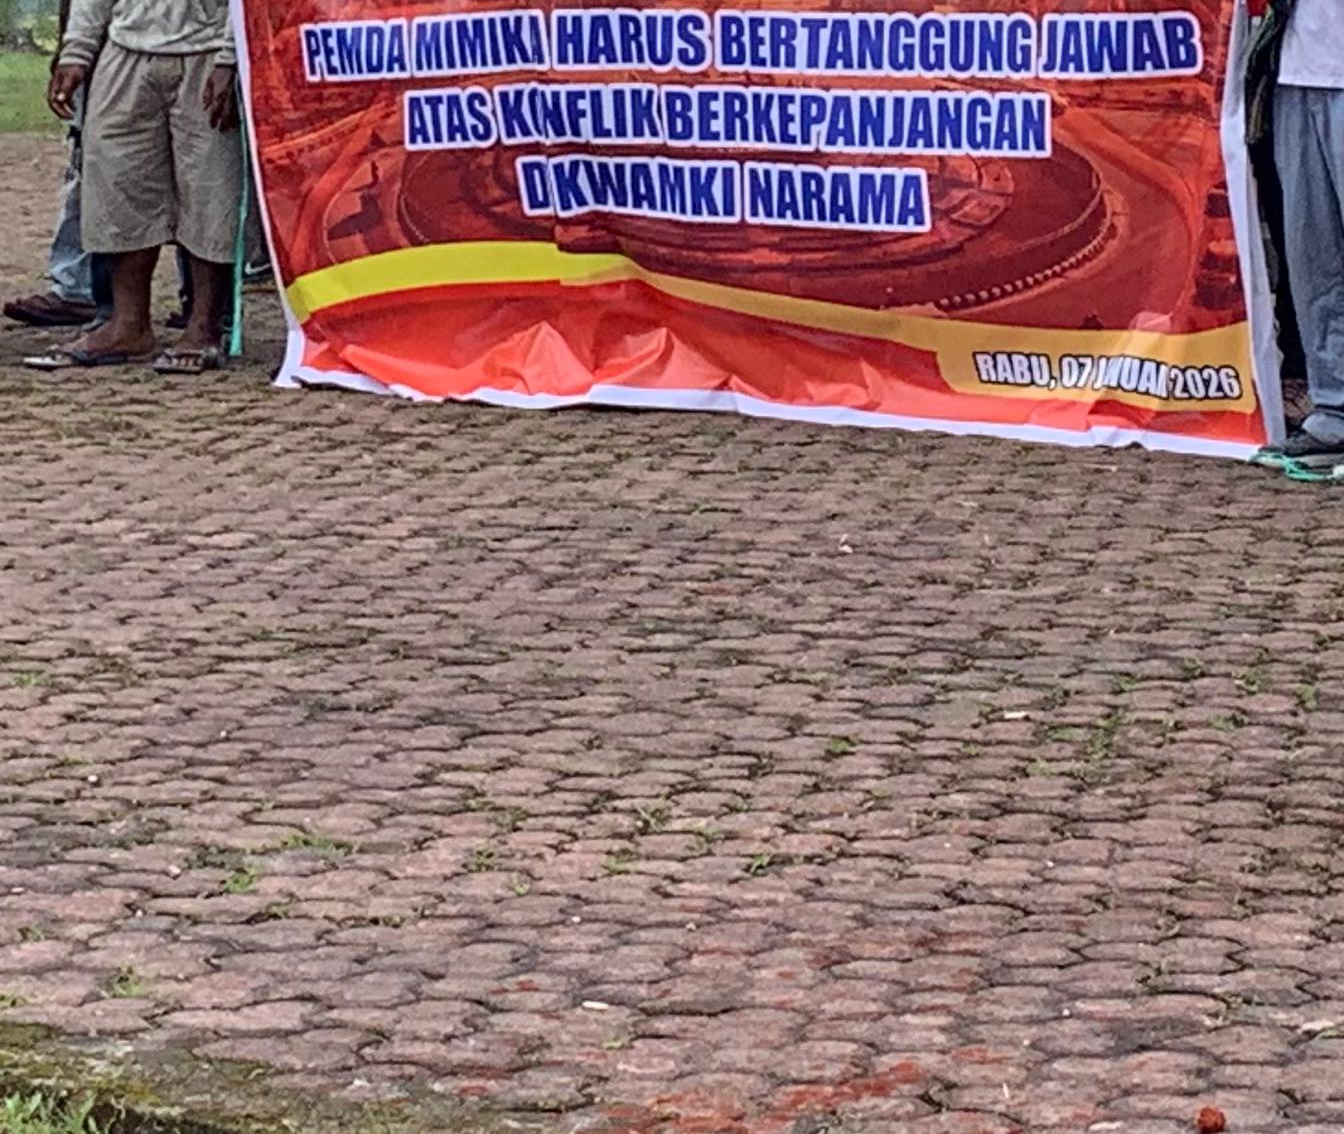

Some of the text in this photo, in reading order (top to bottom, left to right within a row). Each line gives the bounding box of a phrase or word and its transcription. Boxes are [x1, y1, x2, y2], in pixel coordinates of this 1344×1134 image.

[303, 12, 1200, 79] PEMDA MIMIKA HARUS BERTANGGUNG JAWAB
[405, 89, 495, 147] ATAS
[663, 88, 1049, 155] BERKEPANJANGAN
[745, 164, 930, 229] NARAMA
[974, 353, 1055, 389] RABU,
[1061, 355, 1093, 387] 07
[1170, 366, 1242, 400] 2026
